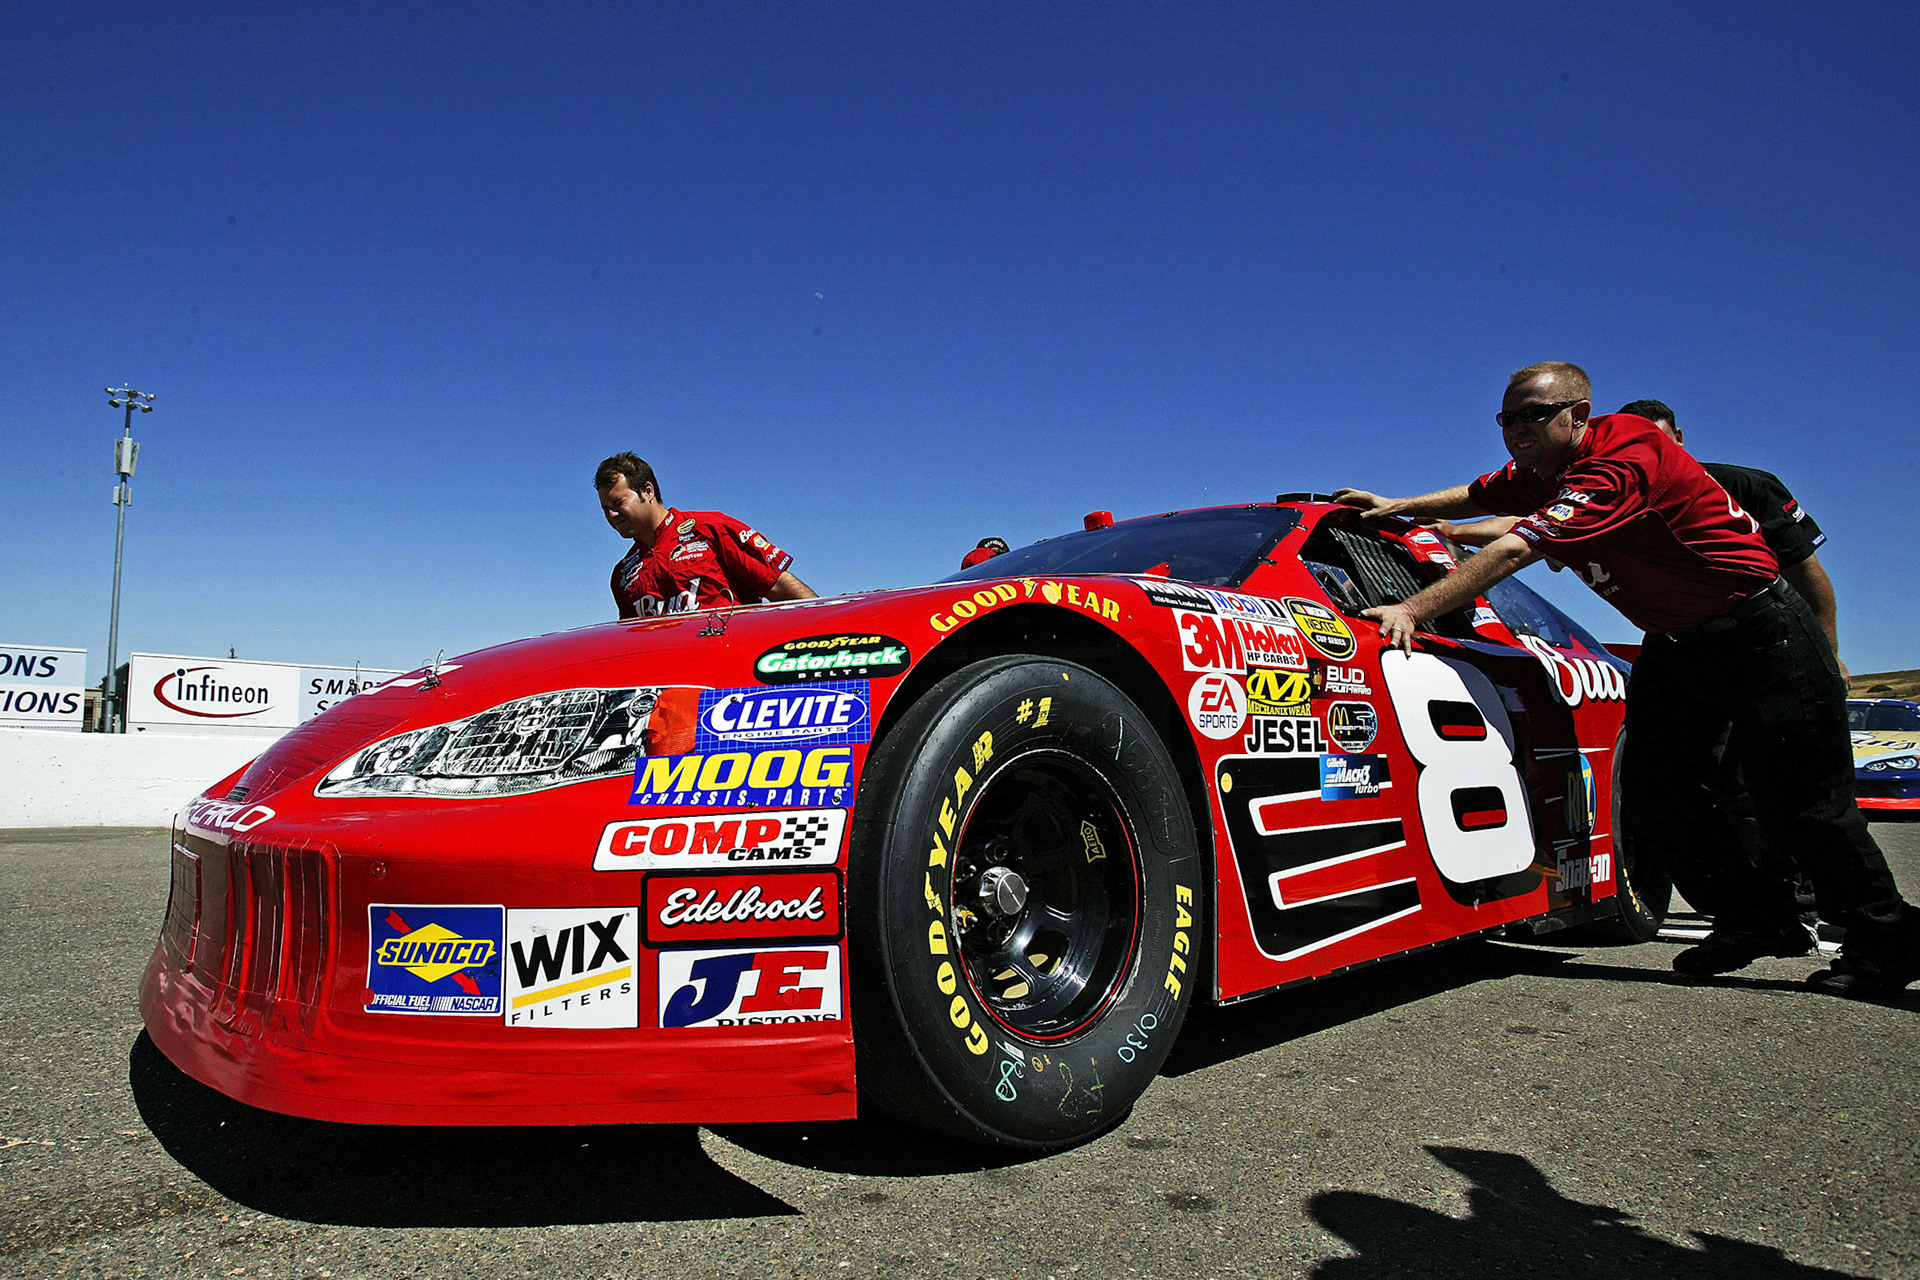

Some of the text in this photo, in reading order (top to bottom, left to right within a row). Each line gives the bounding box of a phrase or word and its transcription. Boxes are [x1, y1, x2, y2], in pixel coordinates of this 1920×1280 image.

[930, 578, 1120, 632] GOODYEAR
[1204, 590, 1267, 615] Mobil
[1303, 617, 1343, 635] NEXTEL
[1315, 635, 1327, 643] CUP
[784, 636, 881, 650] GOODYEAR
[1180, 613, 1245, 670] 3M
[1237, 620, 1305, 666] Holley
[757, 646, 906, 673] Gatorback
[1247, 652, 1296, 665] HP CARBS
[798, 668, 868, 679] BELTS
[1327, 665, 1365, 684] BUD
[1200, 678, 1237, 713] EA
[1247, 699, 1312, 717] MECHANIX WEAR
[711, 693, 852, 732] CLEVITE
[1016, 697, 1052, 729] #1
[1199, 713, 1238, 729] SPORTS
[722, 726, 845, 740] ENGINE PARTS
[1246, 717, 1328, 753] JESEL
[635, 747, 851, 794] MOOG
[1381, 650, 1536, 883] 8
[640, 788, 843, 806] CHASSIS PARTS
[1354, 782, 1379, 794] Turbo
[609, 819, 782, 857] COMP
[1084, 827, 1100, 854] AERO
[728, 847, 812, 861] CAMS
[660, 885, 826, 927] Edelbrock
[927, 730, 994, 1056] GOODYEAR
[381, 942, 491, 964] SUNOCO
[510, 913, 630, 989] WIX
[1163, 883, 1195, 1002] EAGLE
[408, 995, 432, 1007] FUEL
[450, 997, 495, 1011] NASCAR
[511, 982, 631, 1025] FILTERS
[663, 951, 830, 1029] JE
